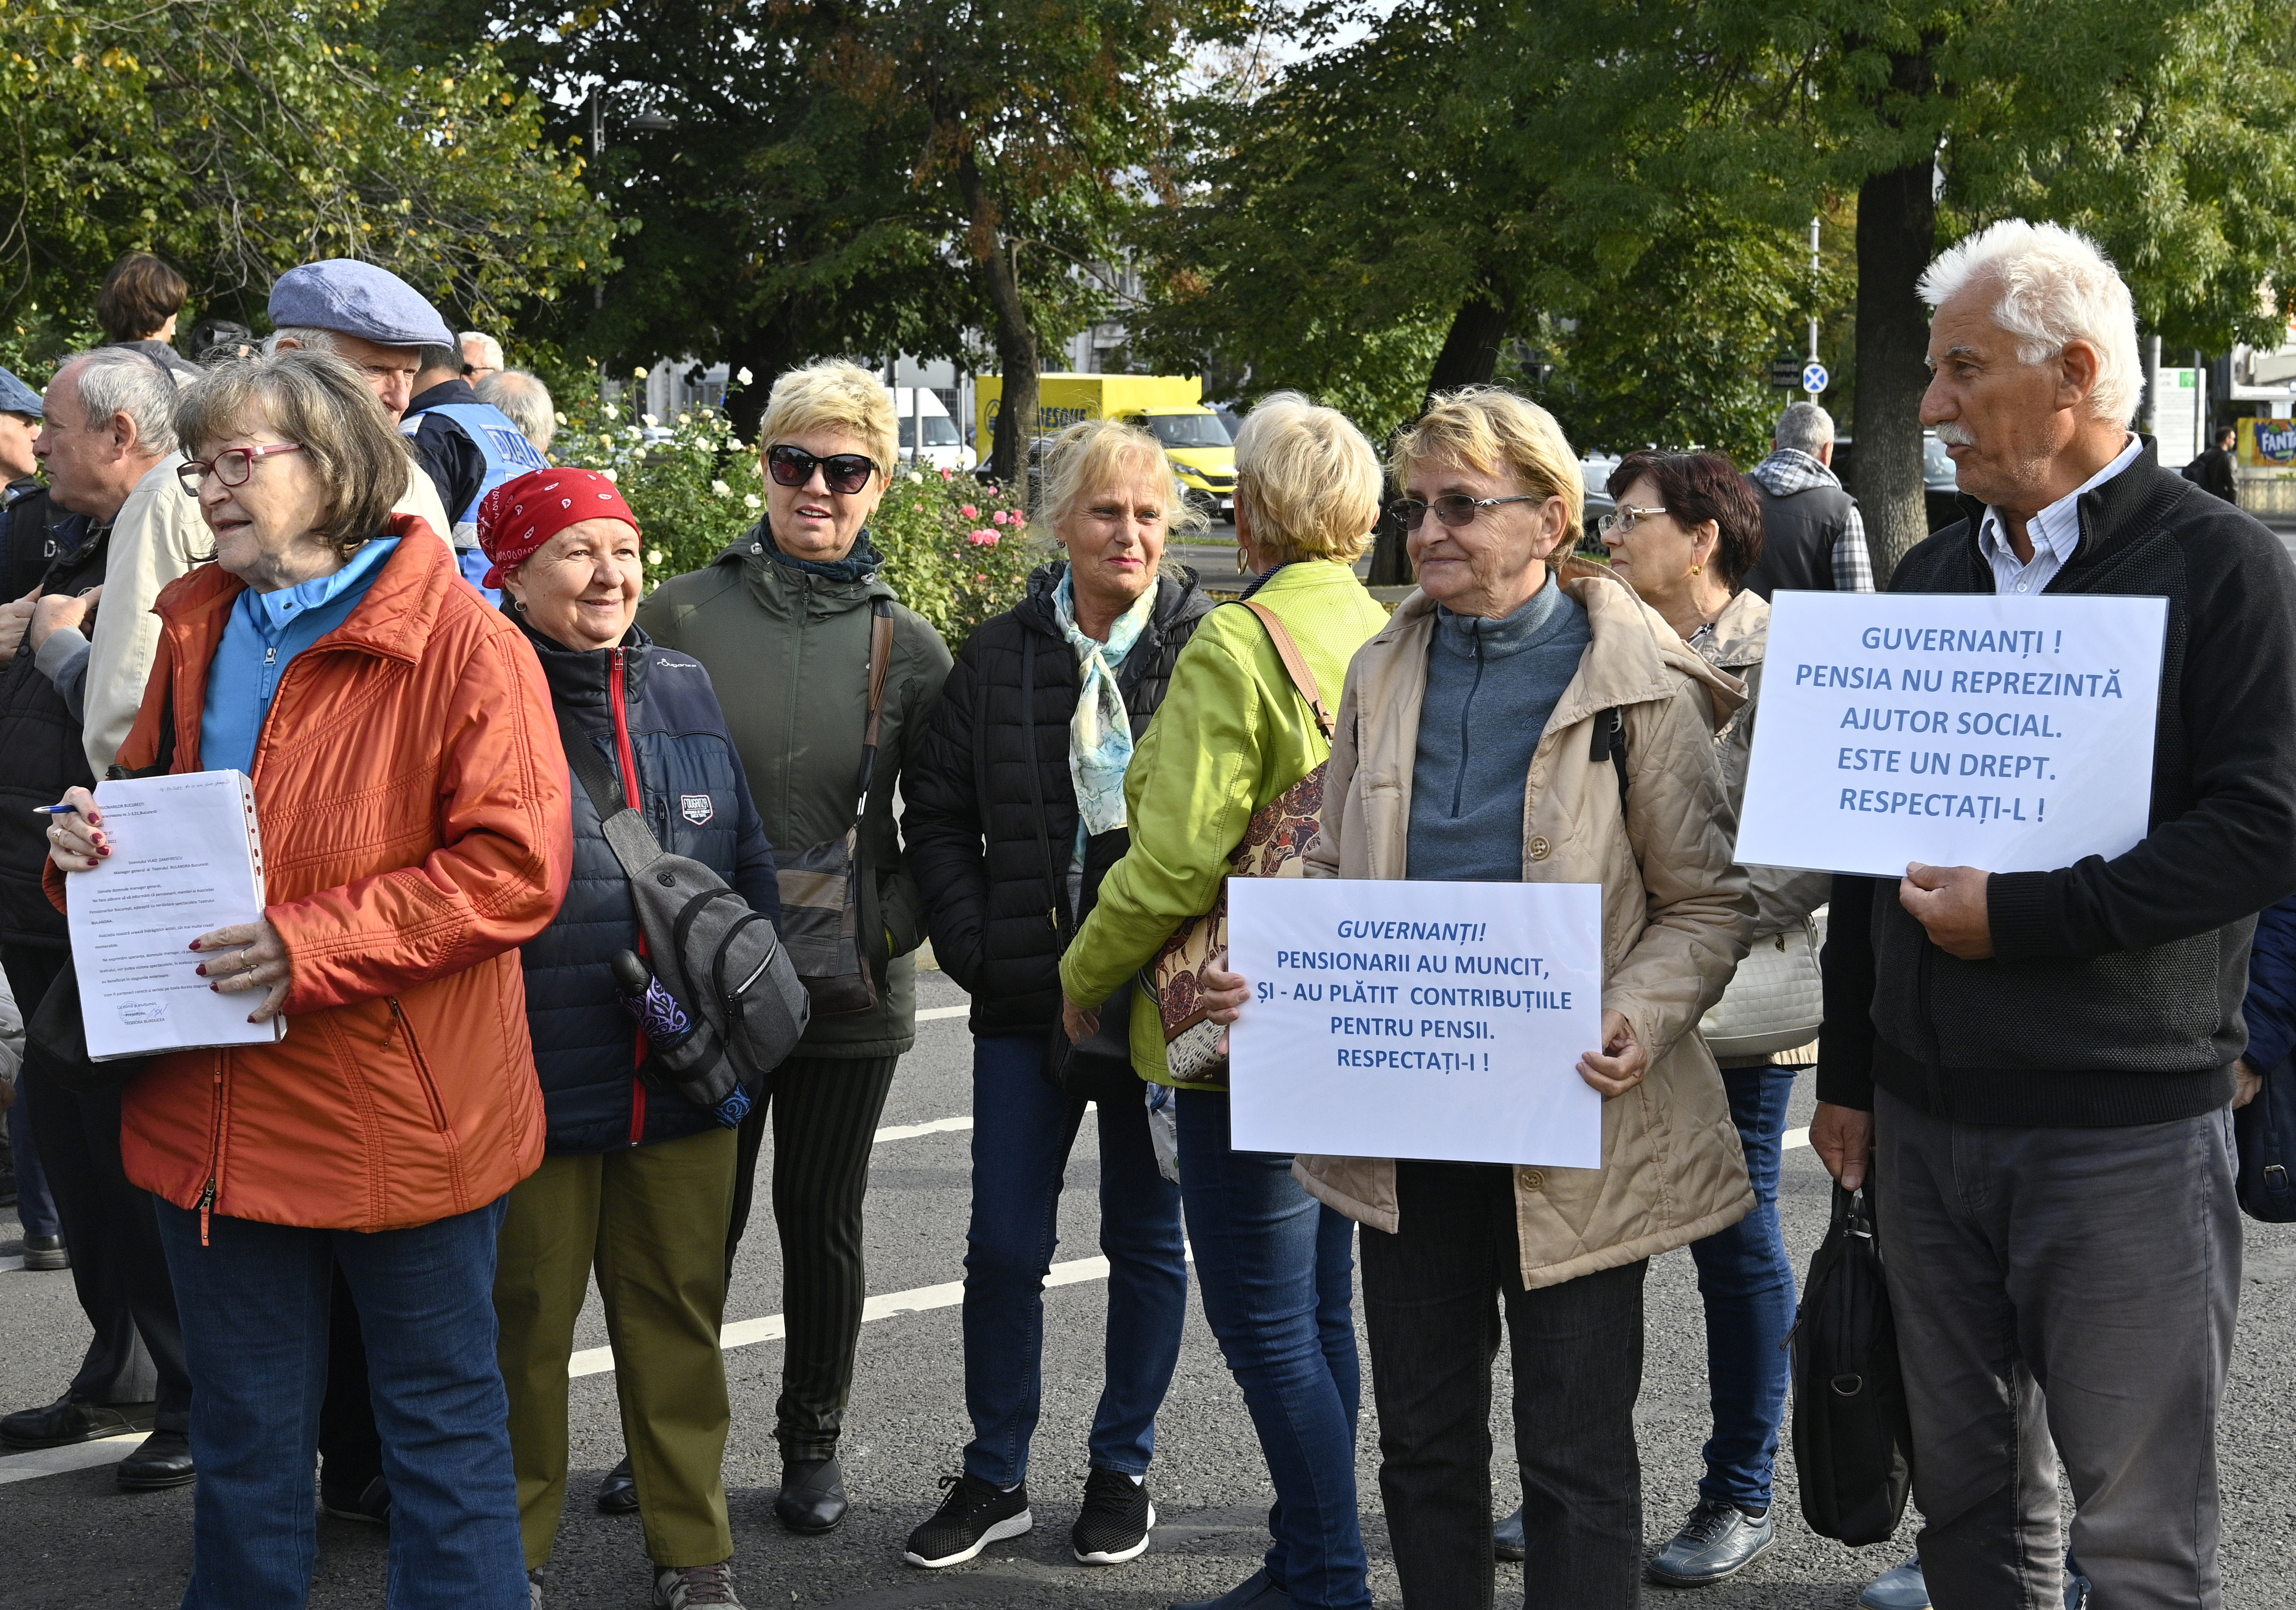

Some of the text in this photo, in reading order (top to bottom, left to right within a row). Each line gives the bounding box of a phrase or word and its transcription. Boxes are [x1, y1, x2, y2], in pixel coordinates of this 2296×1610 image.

[1862, 627, 2061, 658] GUVERNANȚI !
[1797, 665, 2122, 698] PENSIA NU REPREZINTĂ
[1840, 708, 2061, 737] AJUTOR SOCIAL.
[1838, 747, 2055, 780] ESTE UN DREPT.
[684, 798, 708, 808] FOUGANZA
[1840, 788, 2044, 824] RESPECTAȚI-L !
[1338, 920, 1486, 945] GUVERNANȚI!
[1278, 951, 1549, 979] PENSIONARII AU MUNCIT,
[1258, 982, 1274, 1003] ȘI
[1294, 983, 1323, 1001] AU
[1331, 981, 1399, 1004] PLĂTIT
[1411, 987, 1571, 1013] CONTRIBUȚIILE
[1332, 1017, 1494, 1039] PENTRU PENSII.
[1338, 1049, 1488, 1075] RESPECTAȚI-I !
